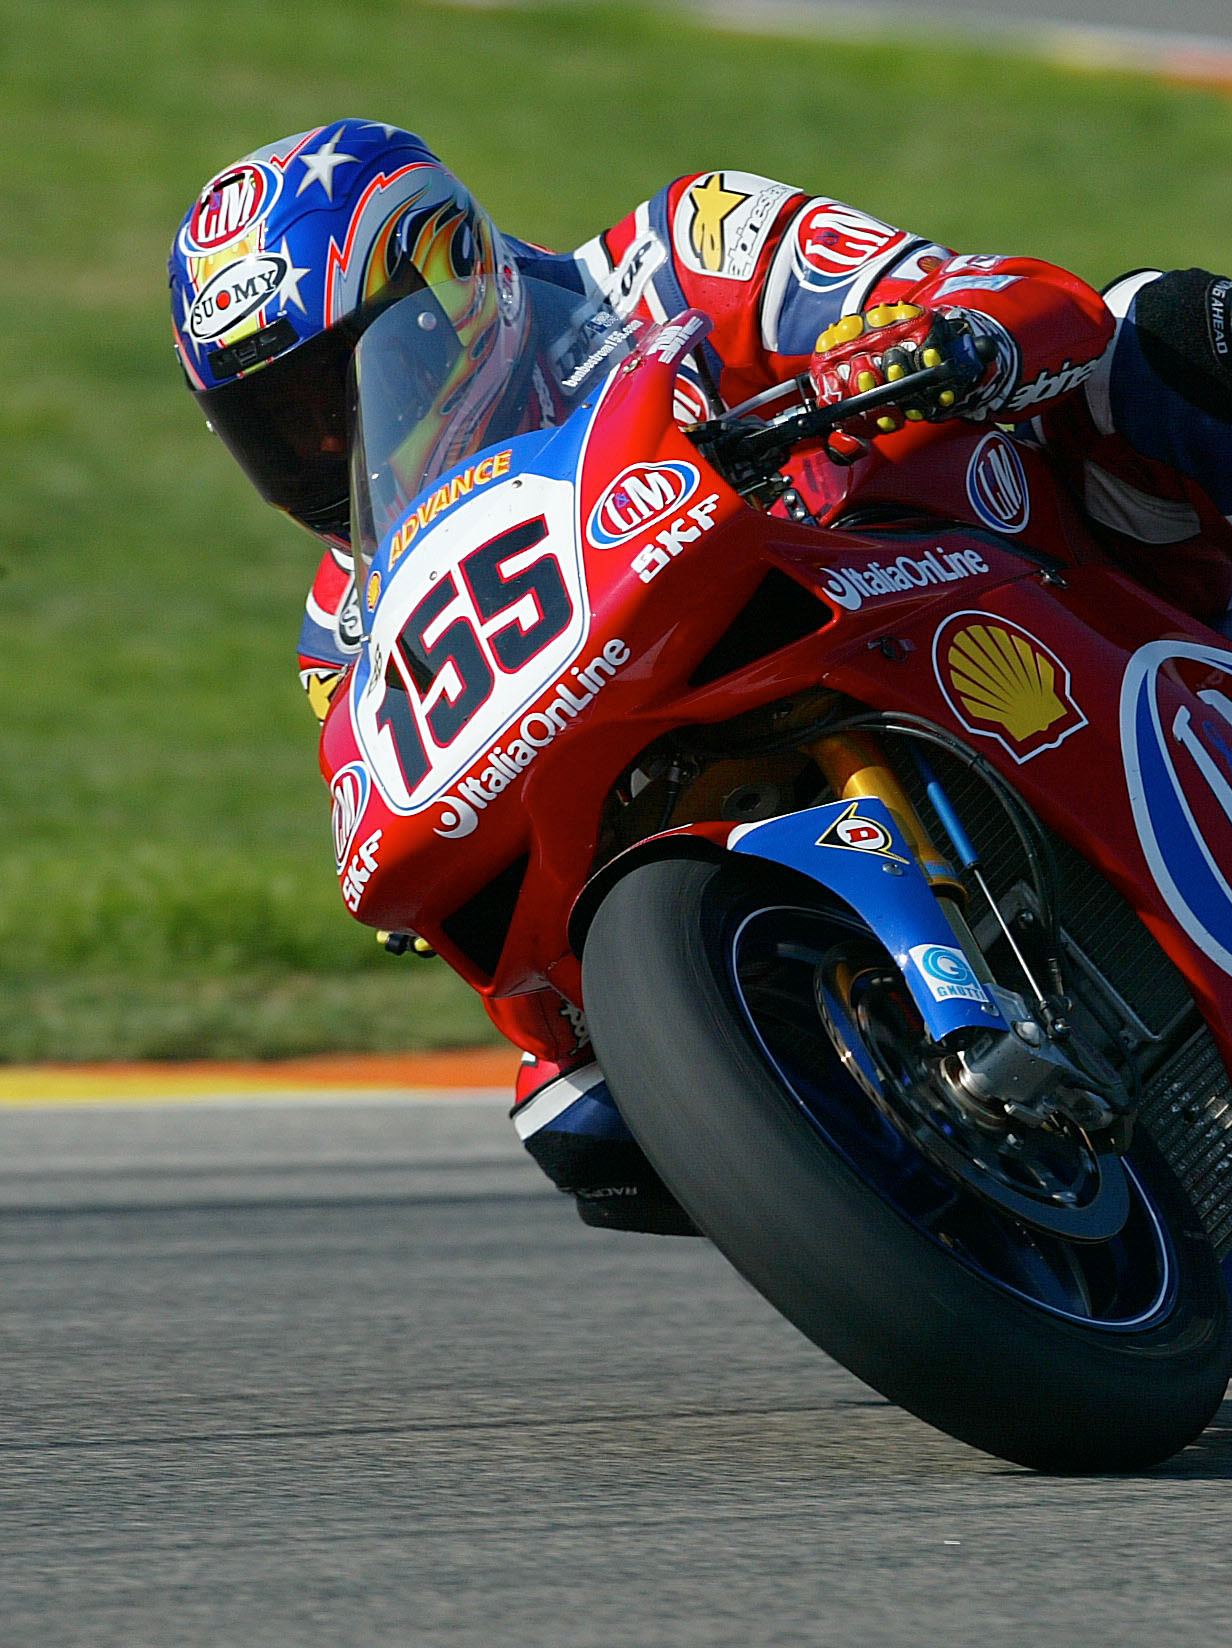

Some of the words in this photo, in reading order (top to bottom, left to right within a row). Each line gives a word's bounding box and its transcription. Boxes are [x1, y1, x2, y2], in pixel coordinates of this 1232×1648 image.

[193, 269, 277, 325] SUOMY
[1211, 301, 1229, 355] AHEAD
[387, 449, 512, 573] ADVANCE
[630, 493, 720, 584] SKF
[841, 546, 990, 598] ItaliaOnLine
[375, 512, 574, 798] 155
[457, 637, 632, 811] ItaliaOnLine
[342, 829, 383, 913] SKF
